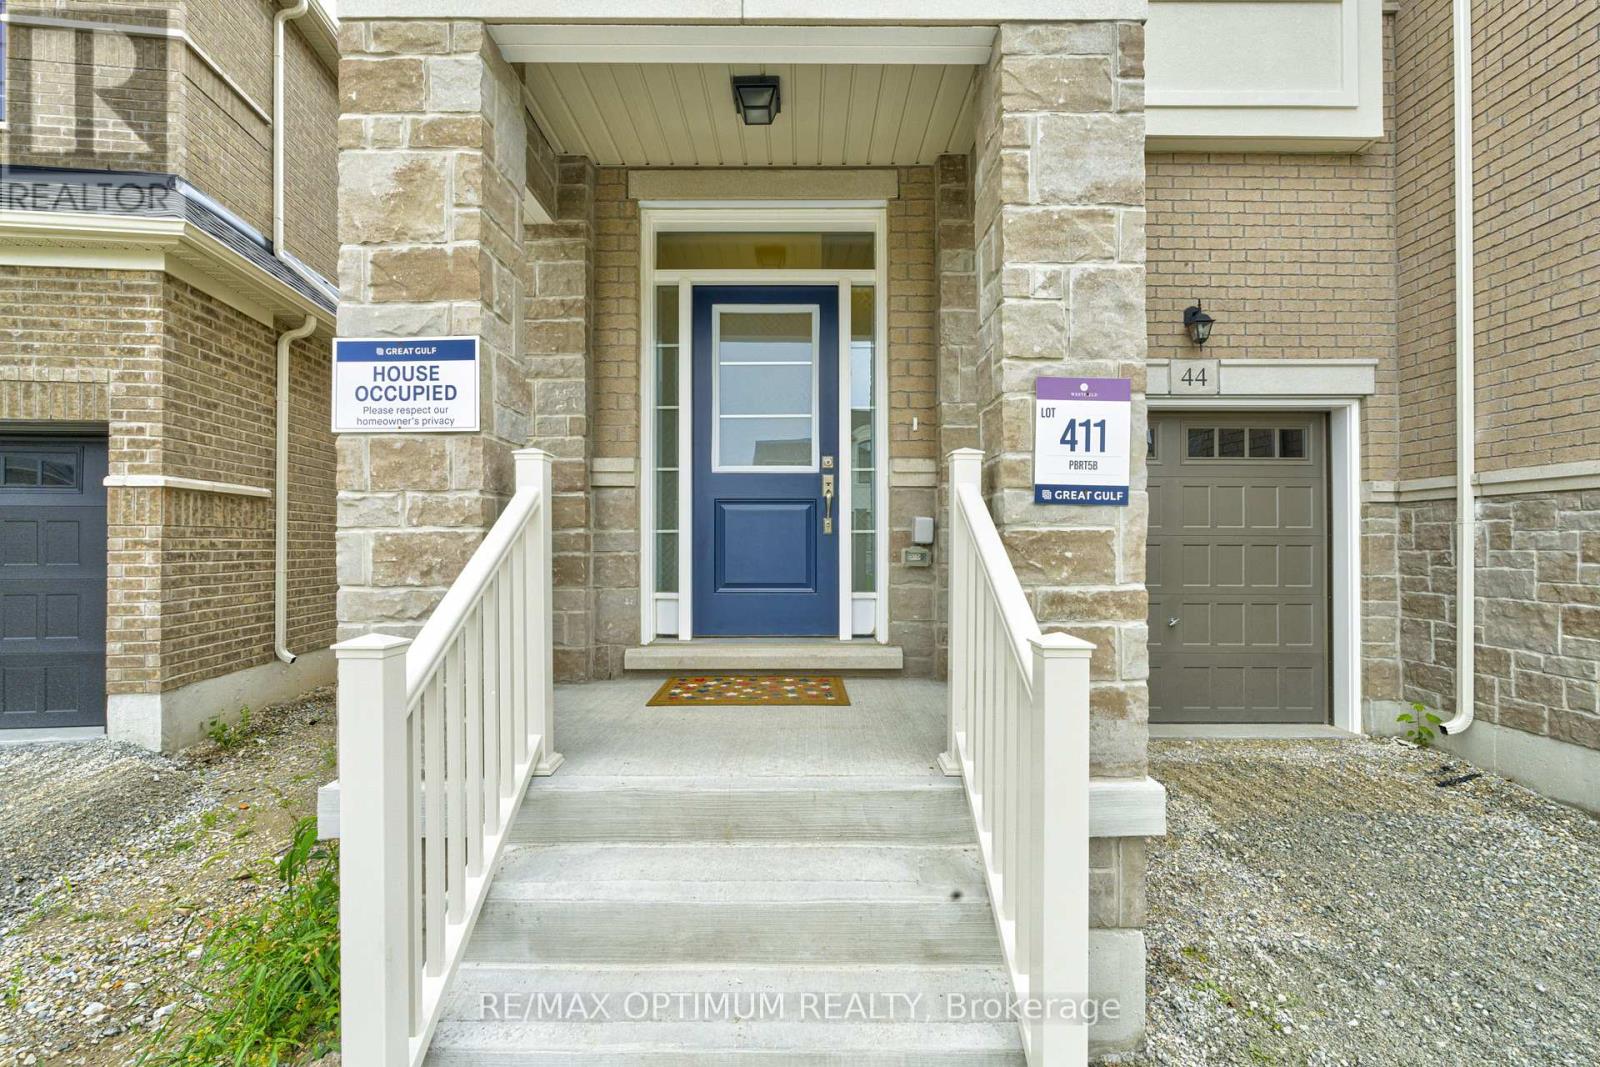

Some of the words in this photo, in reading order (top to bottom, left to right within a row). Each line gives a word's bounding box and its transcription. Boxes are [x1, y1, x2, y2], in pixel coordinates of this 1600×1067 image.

[385, 347, 413, 355] GREAT
[415, 347, 437, 355] GULF
[373, 365, 440, 382] HOUSE
[1181, 367, 1208, 386] 44
[355, 385, 457, 402] OCCUPIED
[363, 406, 394, 415] Please
[396, 406, 431, 417] respect
[1041, 407, 1056, 418] LOT
[356, 417, 419, 426] homeowner's
[421, 417, 455, 427] privacy
[1059, 418, 1106, 453] 411
[1069, 460, 1098, 471] PBRT5B
[1054, 490, 1092, 500] GREAT
[1094, 491, 1123, 501] GULF
